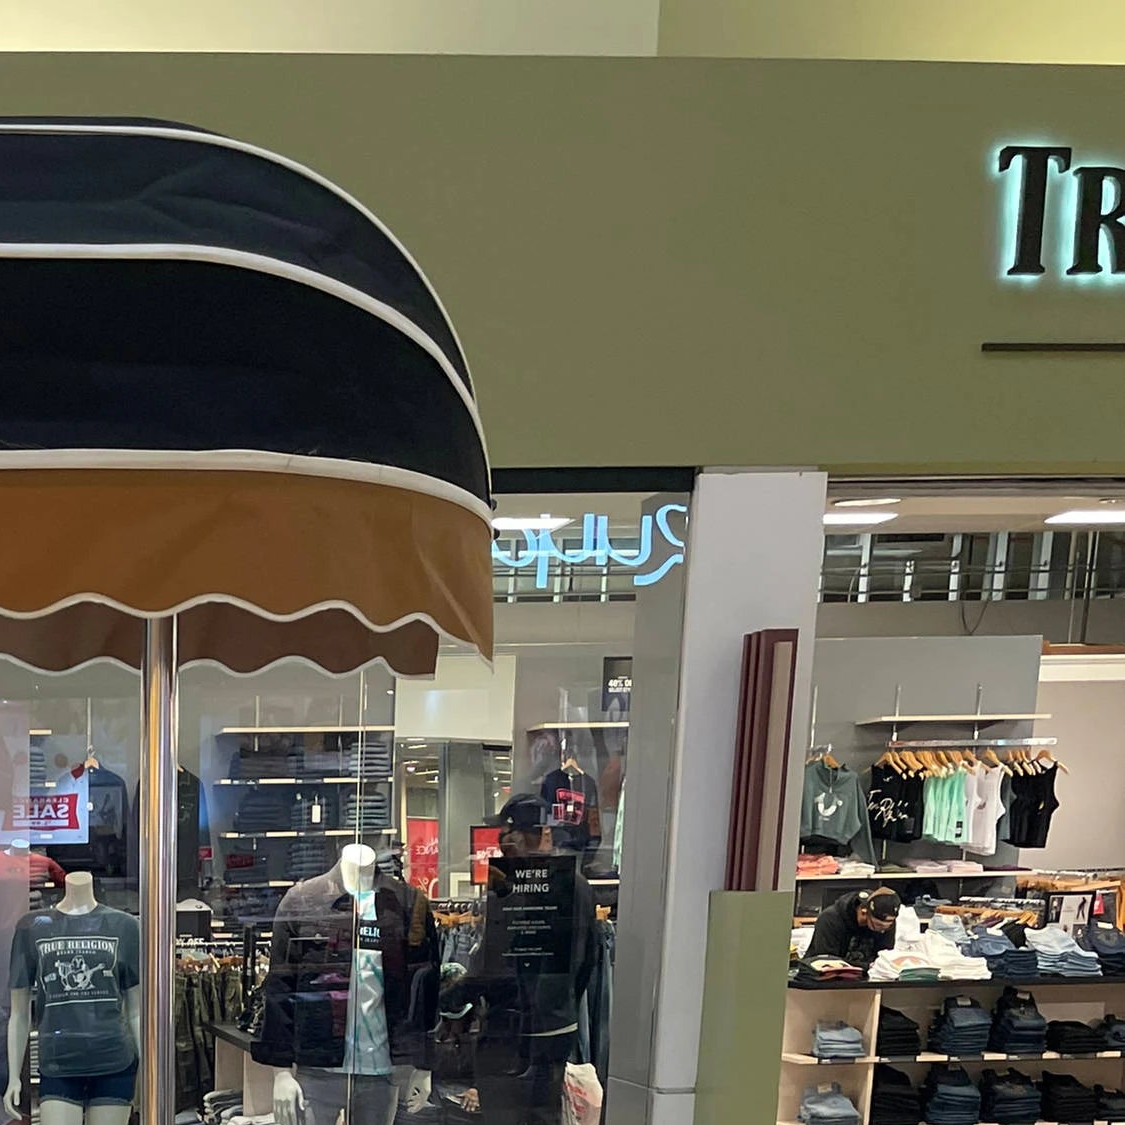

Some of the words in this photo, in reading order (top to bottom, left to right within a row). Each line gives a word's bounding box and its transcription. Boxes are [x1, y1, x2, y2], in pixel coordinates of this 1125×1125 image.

[515, 868, 548, 879] WE'RE
[512, 883, 550, 893] HIRING
[39, 941, 66, 956] TRUE
[67, 939, 116, 955] RELIGION
